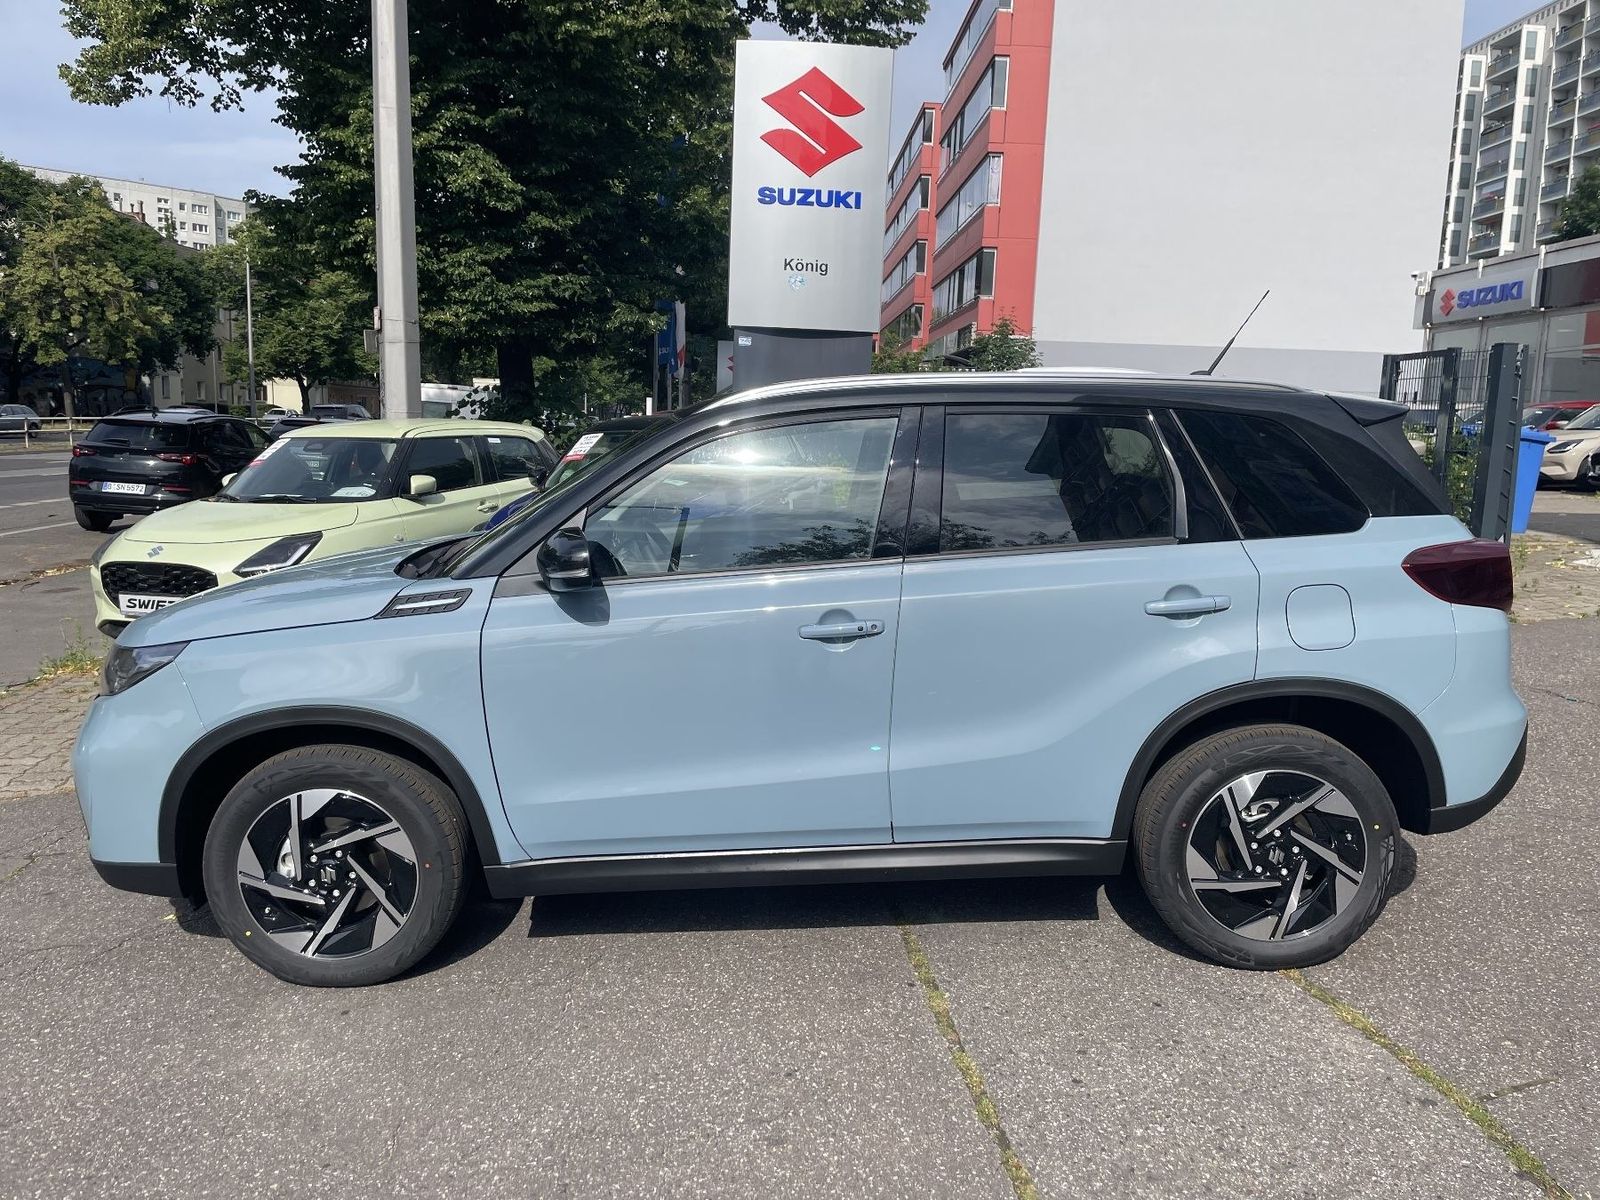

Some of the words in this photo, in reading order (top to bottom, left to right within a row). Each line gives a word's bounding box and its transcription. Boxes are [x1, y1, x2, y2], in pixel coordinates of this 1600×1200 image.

[757, 186, 862, 210] SUZUKI
[783, 258, 829, 276] König
[1456, 280, 1524, 309] SUZUKI
[126, 598, 175, 610] SWIF
